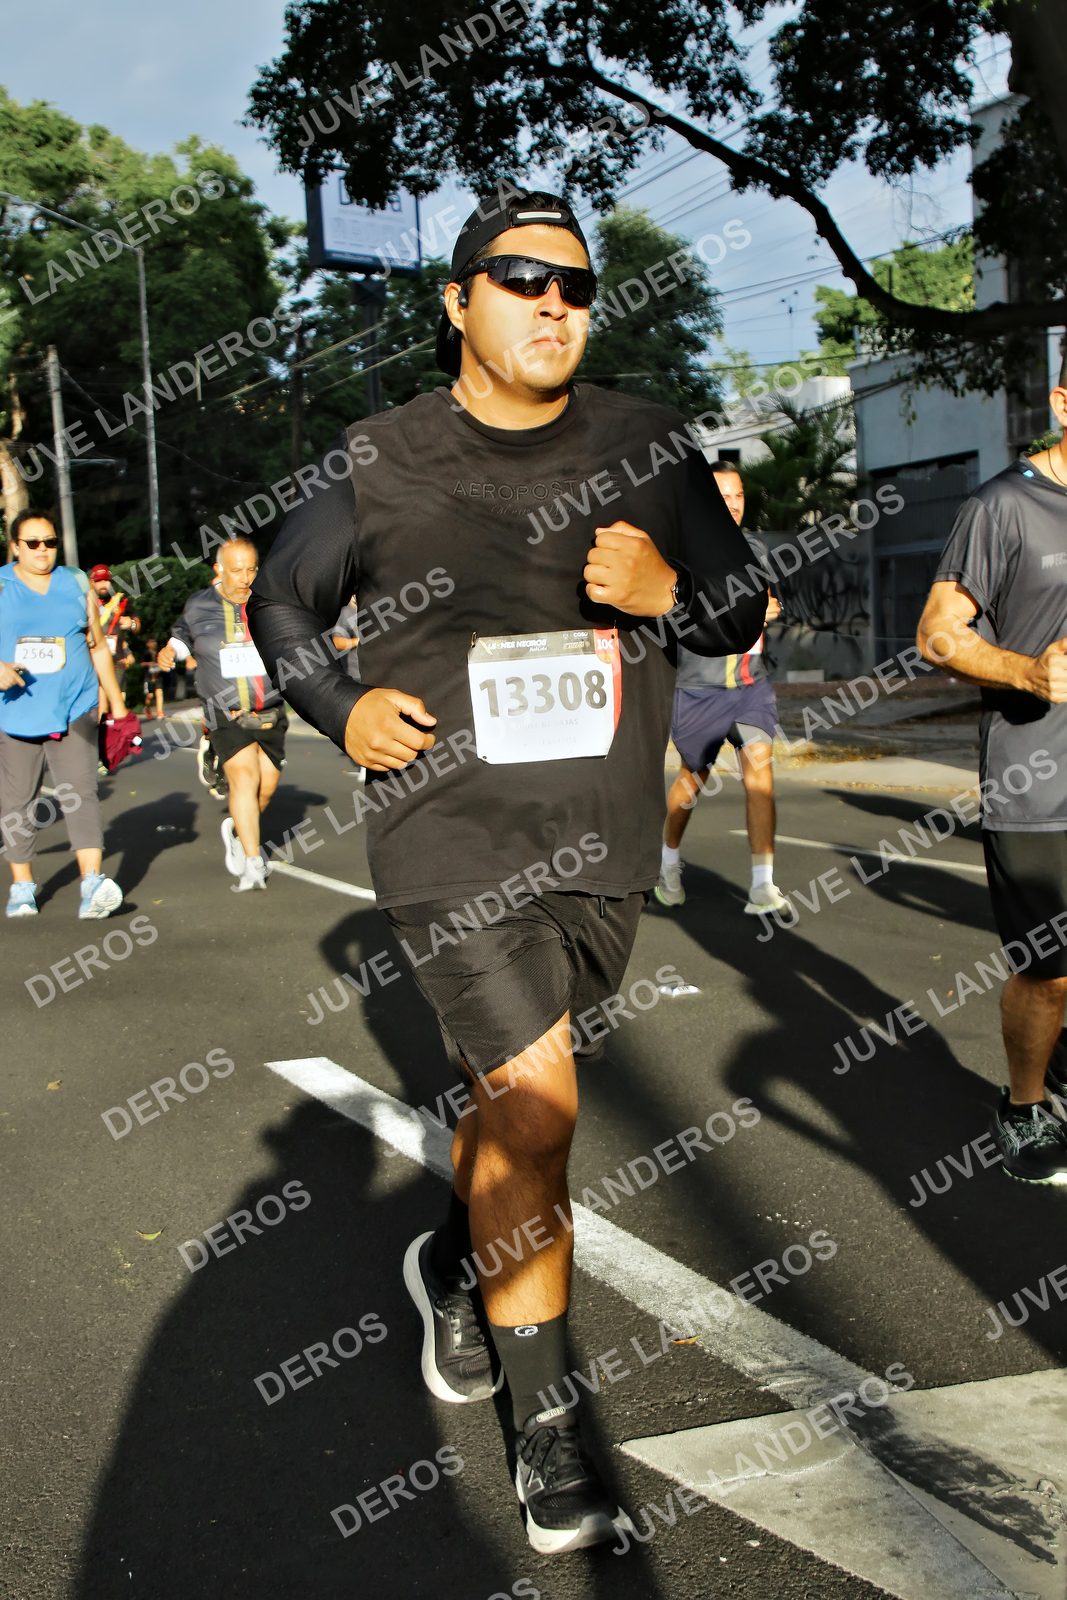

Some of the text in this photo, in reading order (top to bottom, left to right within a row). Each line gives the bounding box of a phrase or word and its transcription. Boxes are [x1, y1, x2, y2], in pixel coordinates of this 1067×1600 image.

[452, 474, 619, 500] AEROPOSTE
[22, 648, 54, 660] 2564
[479, 670, 607, 718] 13308
